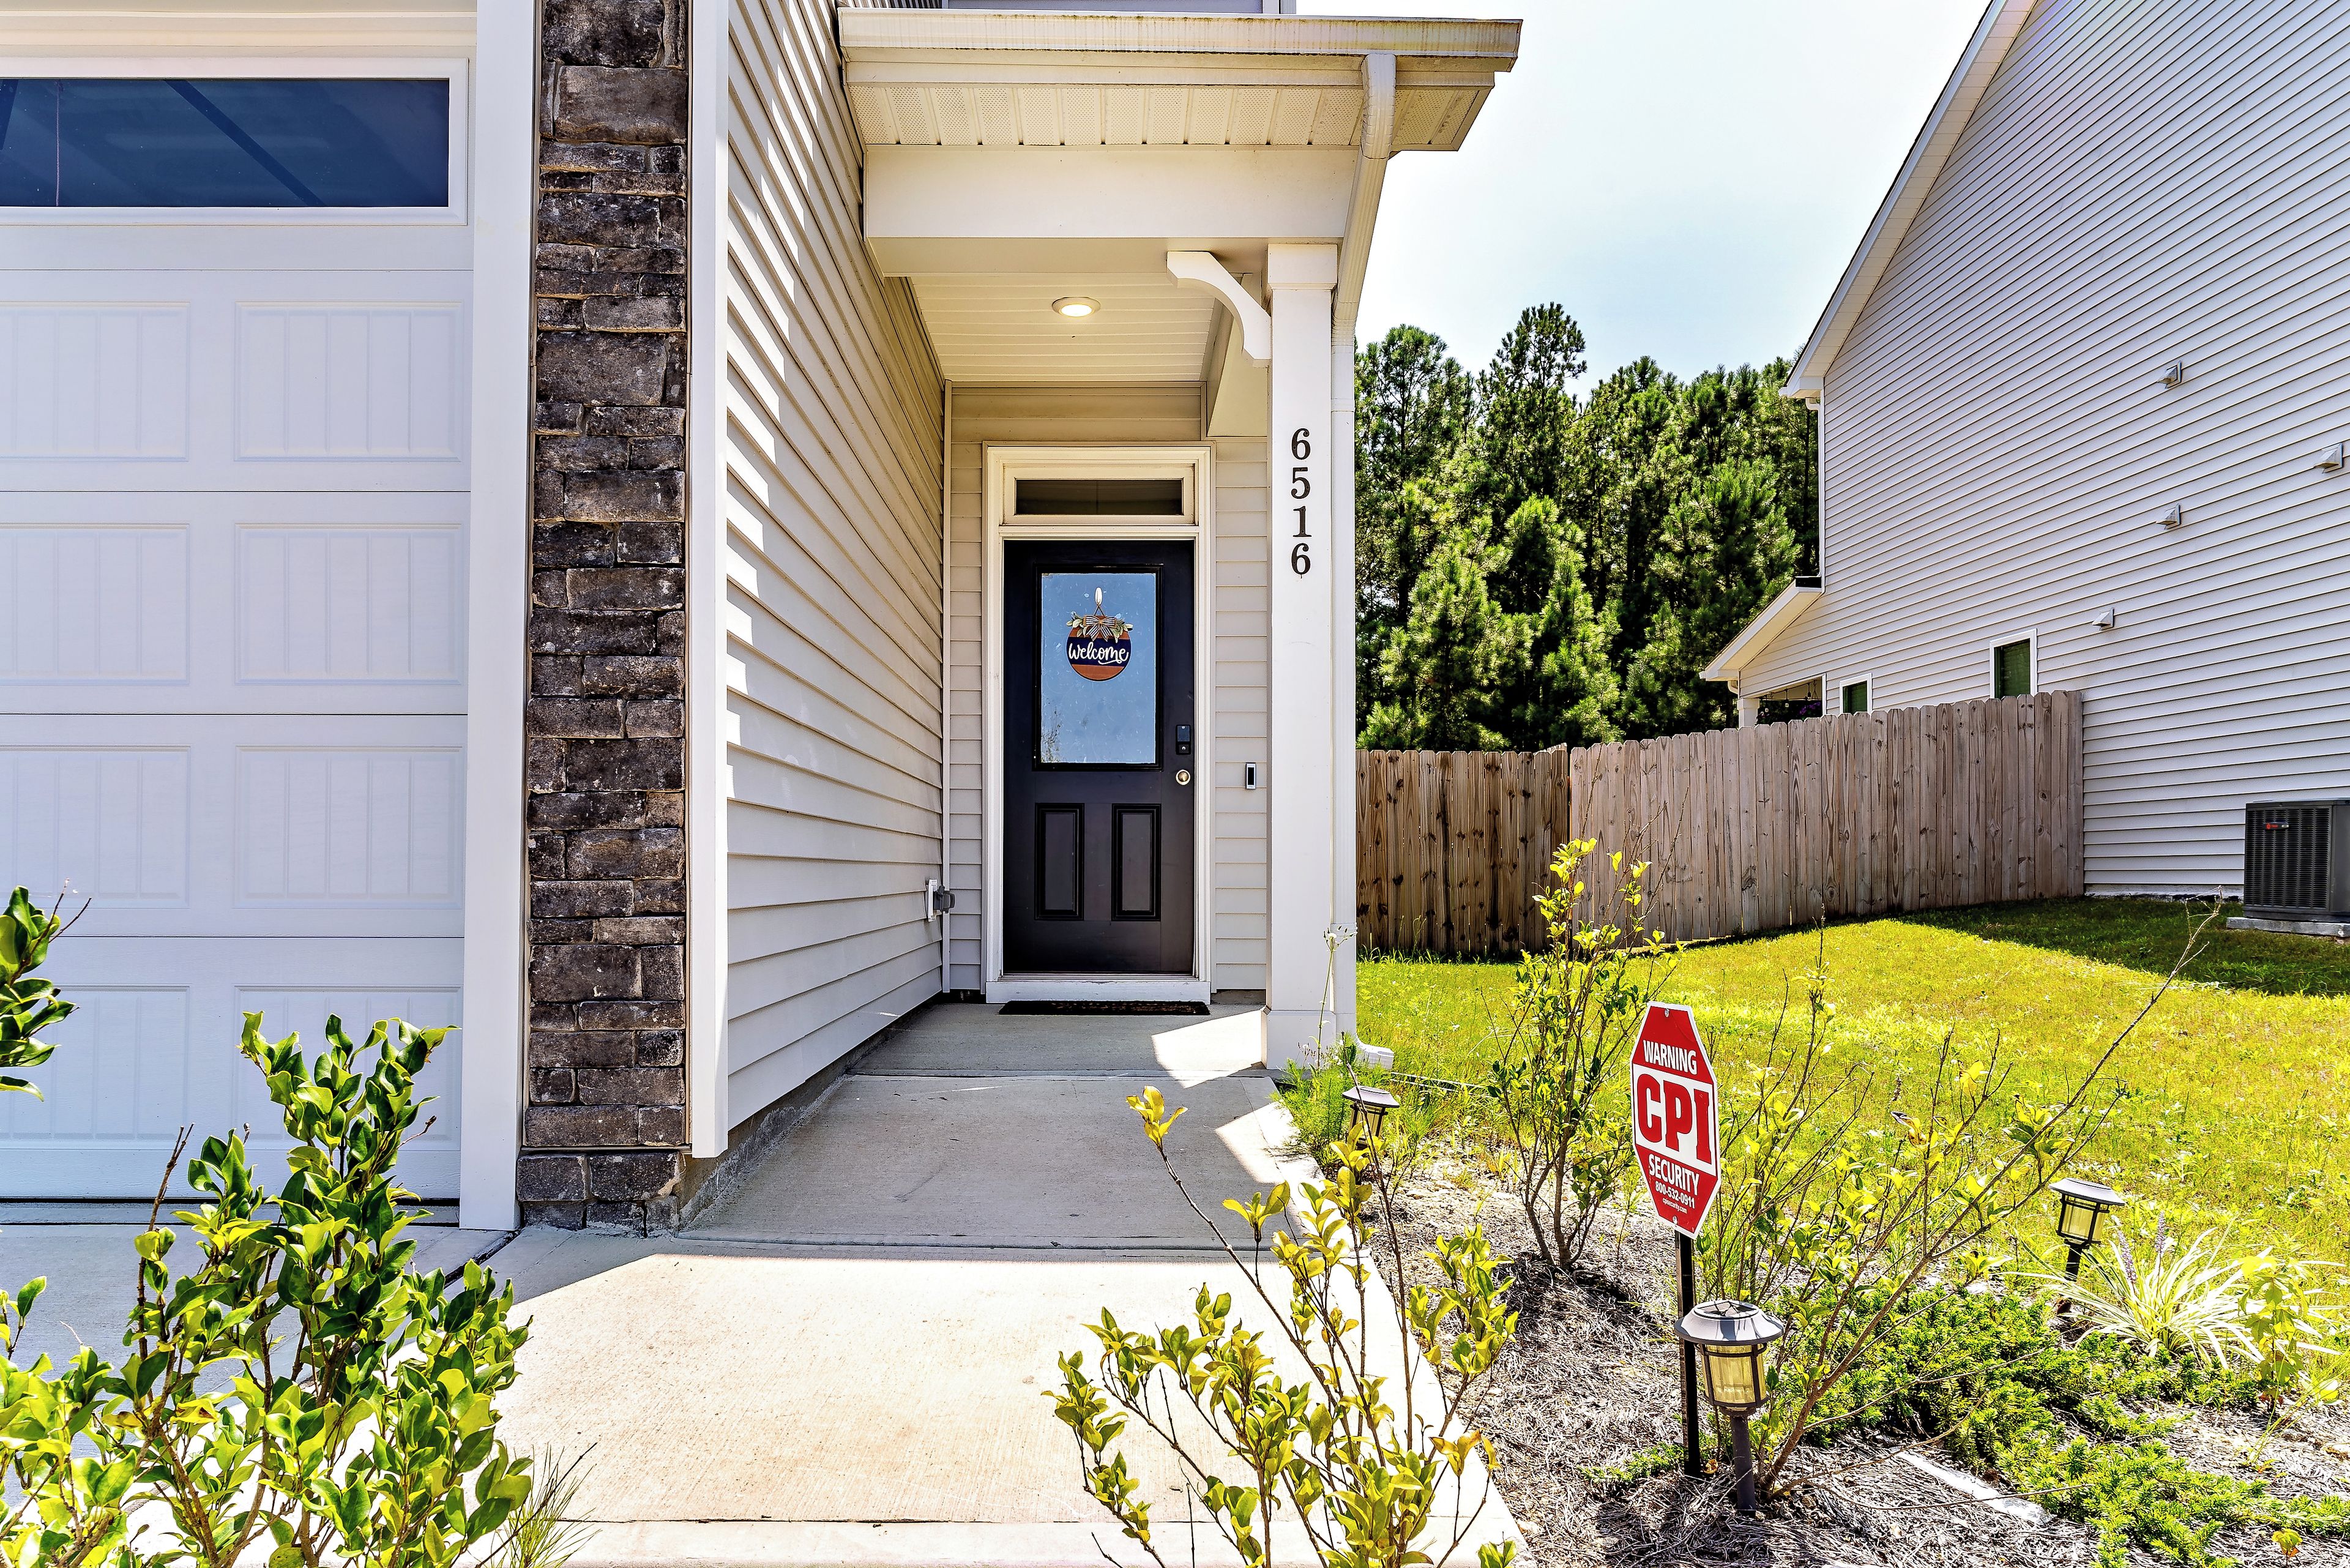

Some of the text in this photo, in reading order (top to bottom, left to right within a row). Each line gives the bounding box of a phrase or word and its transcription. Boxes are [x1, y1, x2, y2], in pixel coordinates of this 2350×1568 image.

[1291, 428, 1312, 575] 6516
[1643, 1039, 1697, 1075] WARNING
[1636, 1073, 1712, 1165] CPI
[1649, 1153, 1700, 1196] SECURITY
[1655, 1181, 1696, 1209] 800-532-0911
